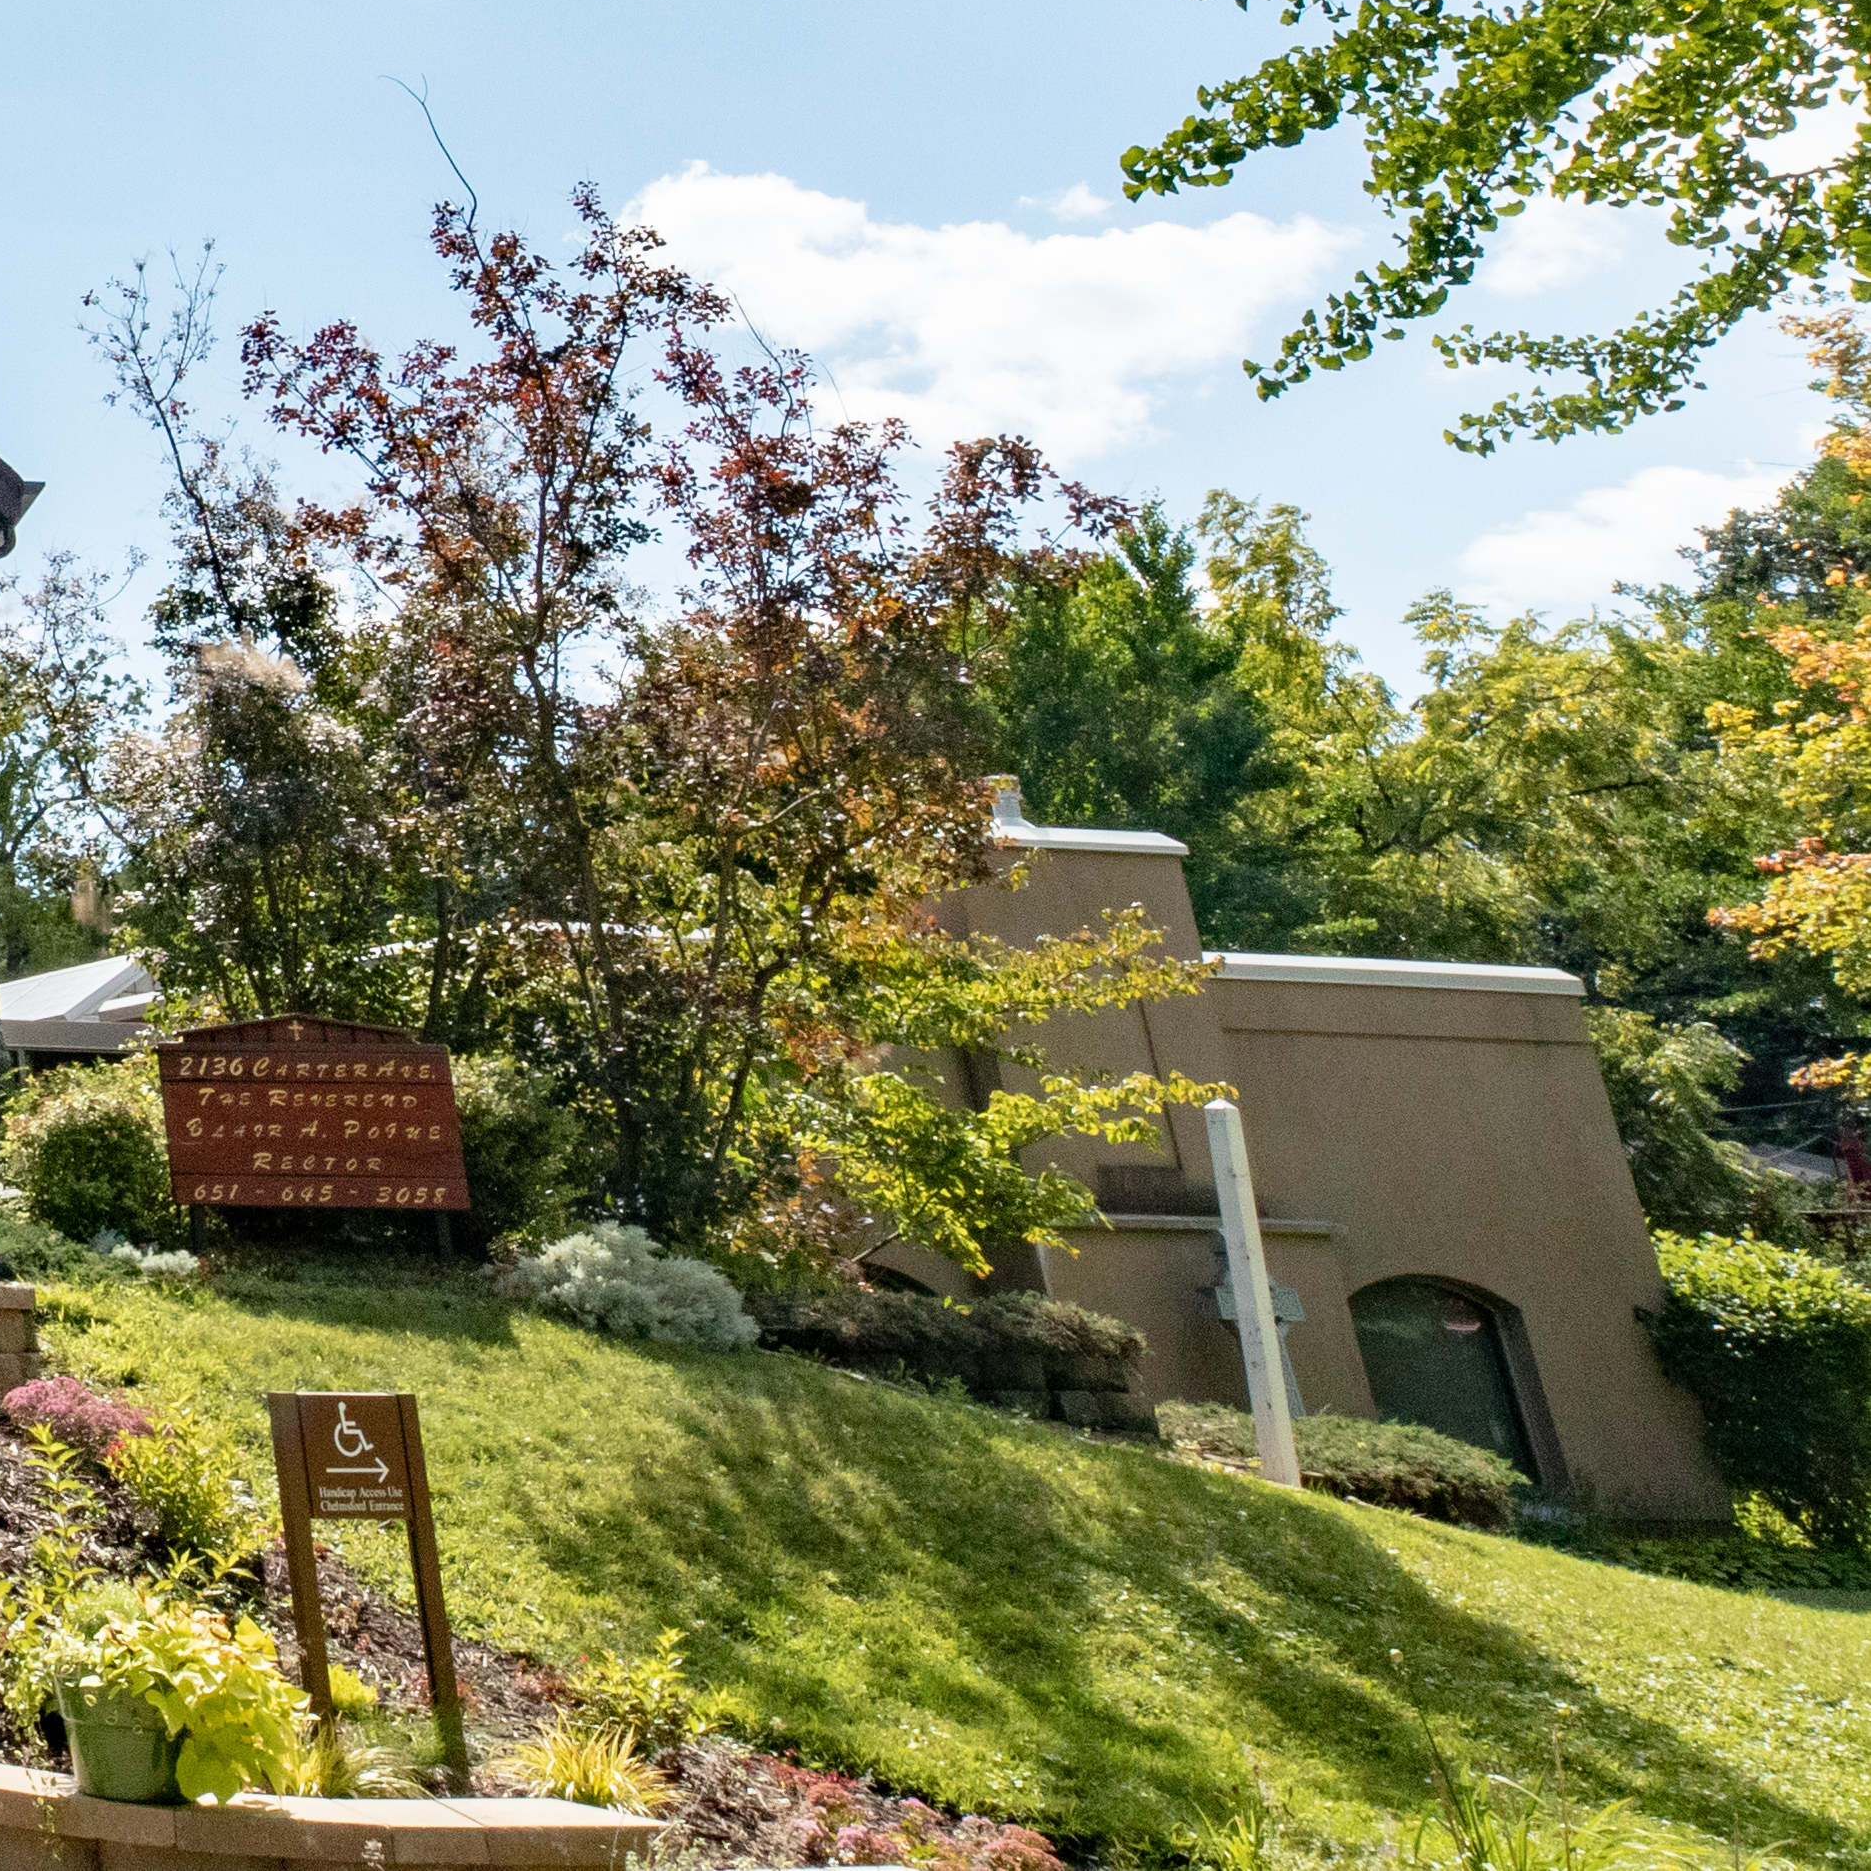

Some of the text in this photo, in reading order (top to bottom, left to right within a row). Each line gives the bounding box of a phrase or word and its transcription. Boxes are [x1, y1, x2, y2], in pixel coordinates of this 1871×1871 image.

[180, 1056, 436, 1079] 2136 CARTER AVE.
[199, 1087, 418, 1108] THE REVEREND
[185, 1117, 282, 1138] BLAIR
[343, 1119, 441, 1140] POGUE
[253, 1152, 381, 1171] RECTOR
[319, 1485, 404, 1501] Handicap Access Use
[369, 1500, 405, 1512] Entrance
